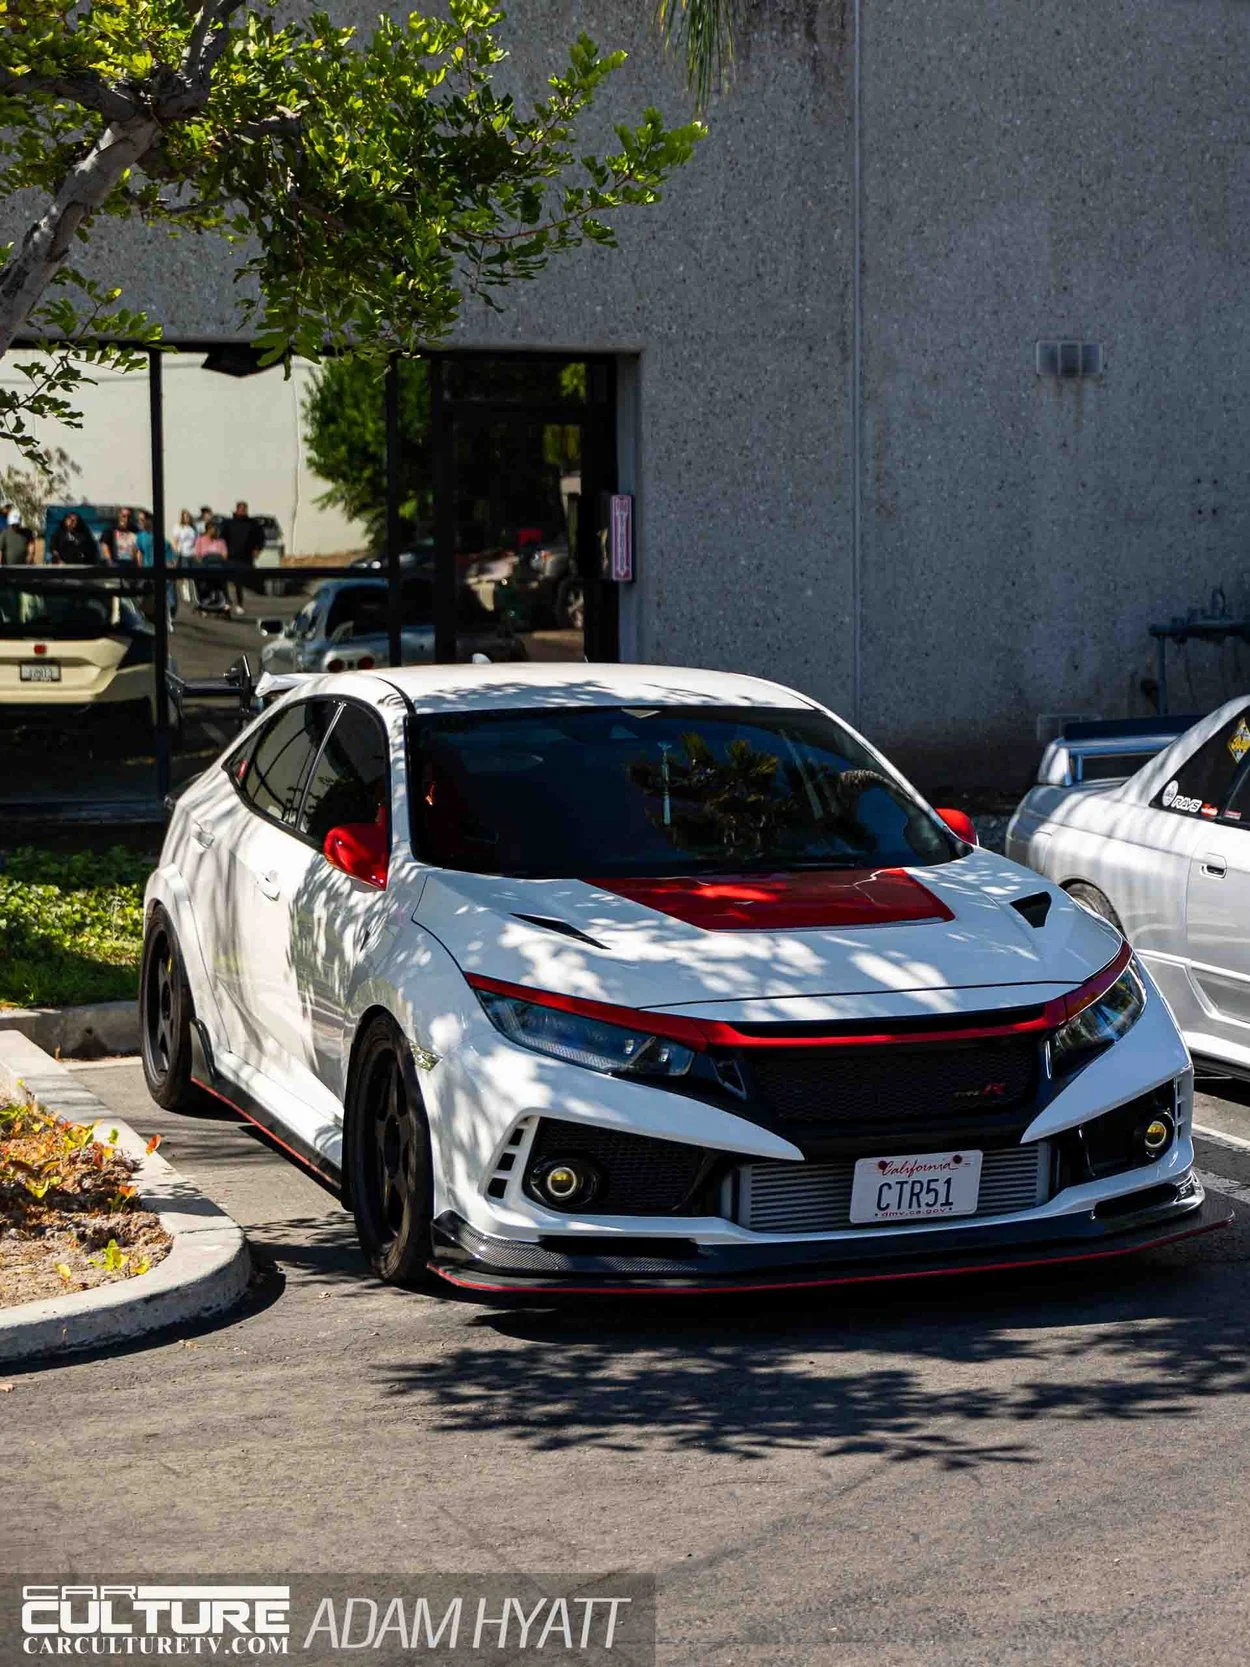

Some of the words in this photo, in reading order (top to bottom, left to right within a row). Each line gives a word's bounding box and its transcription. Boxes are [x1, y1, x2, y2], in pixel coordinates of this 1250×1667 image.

[1171, 795, 1202, 812] RAYS
[881, 1158, 959, 1178] California
[876, 1176, 954, 1212] CTR51
[881, 1206, 948, 1217] dmv.ca.gov
